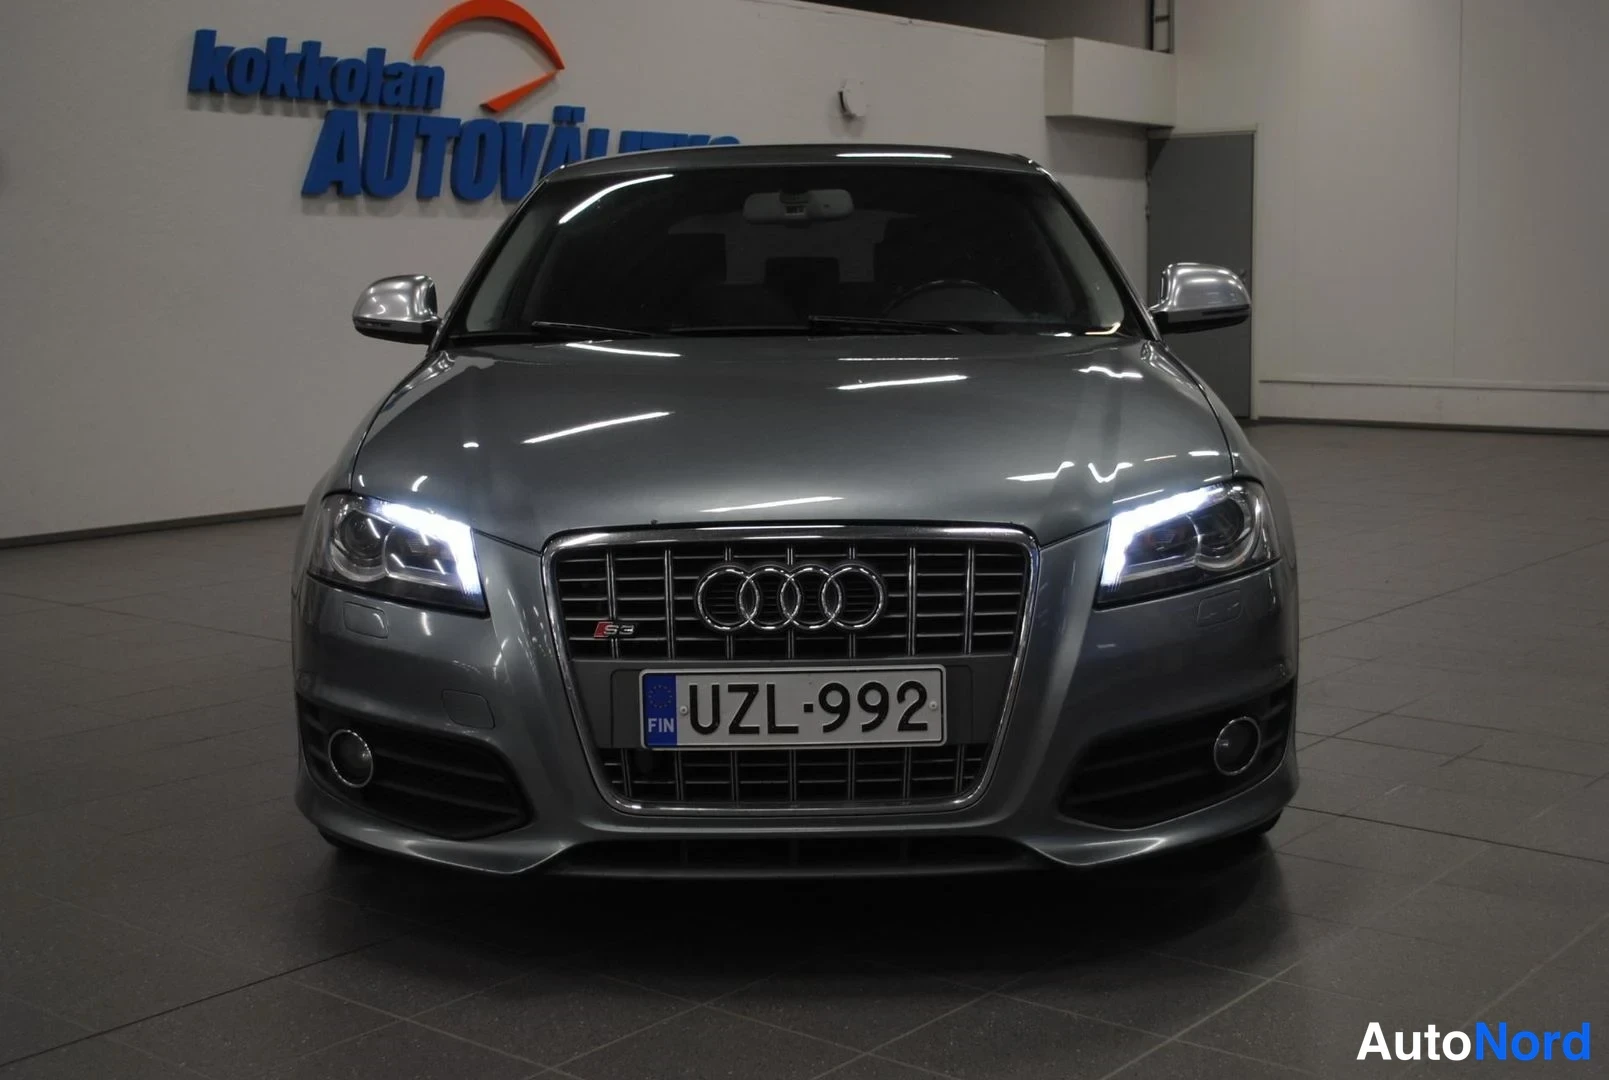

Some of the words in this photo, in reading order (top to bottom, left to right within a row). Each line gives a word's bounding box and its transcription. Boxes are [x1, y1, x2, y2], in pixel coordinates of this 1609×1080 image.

[188, 29, 445, 110] kokkolan
[301, 105, 740, 201] AUTOVÄ
[604, 624, 634, 635] S3
[648, 717, 675, 733] FIN
